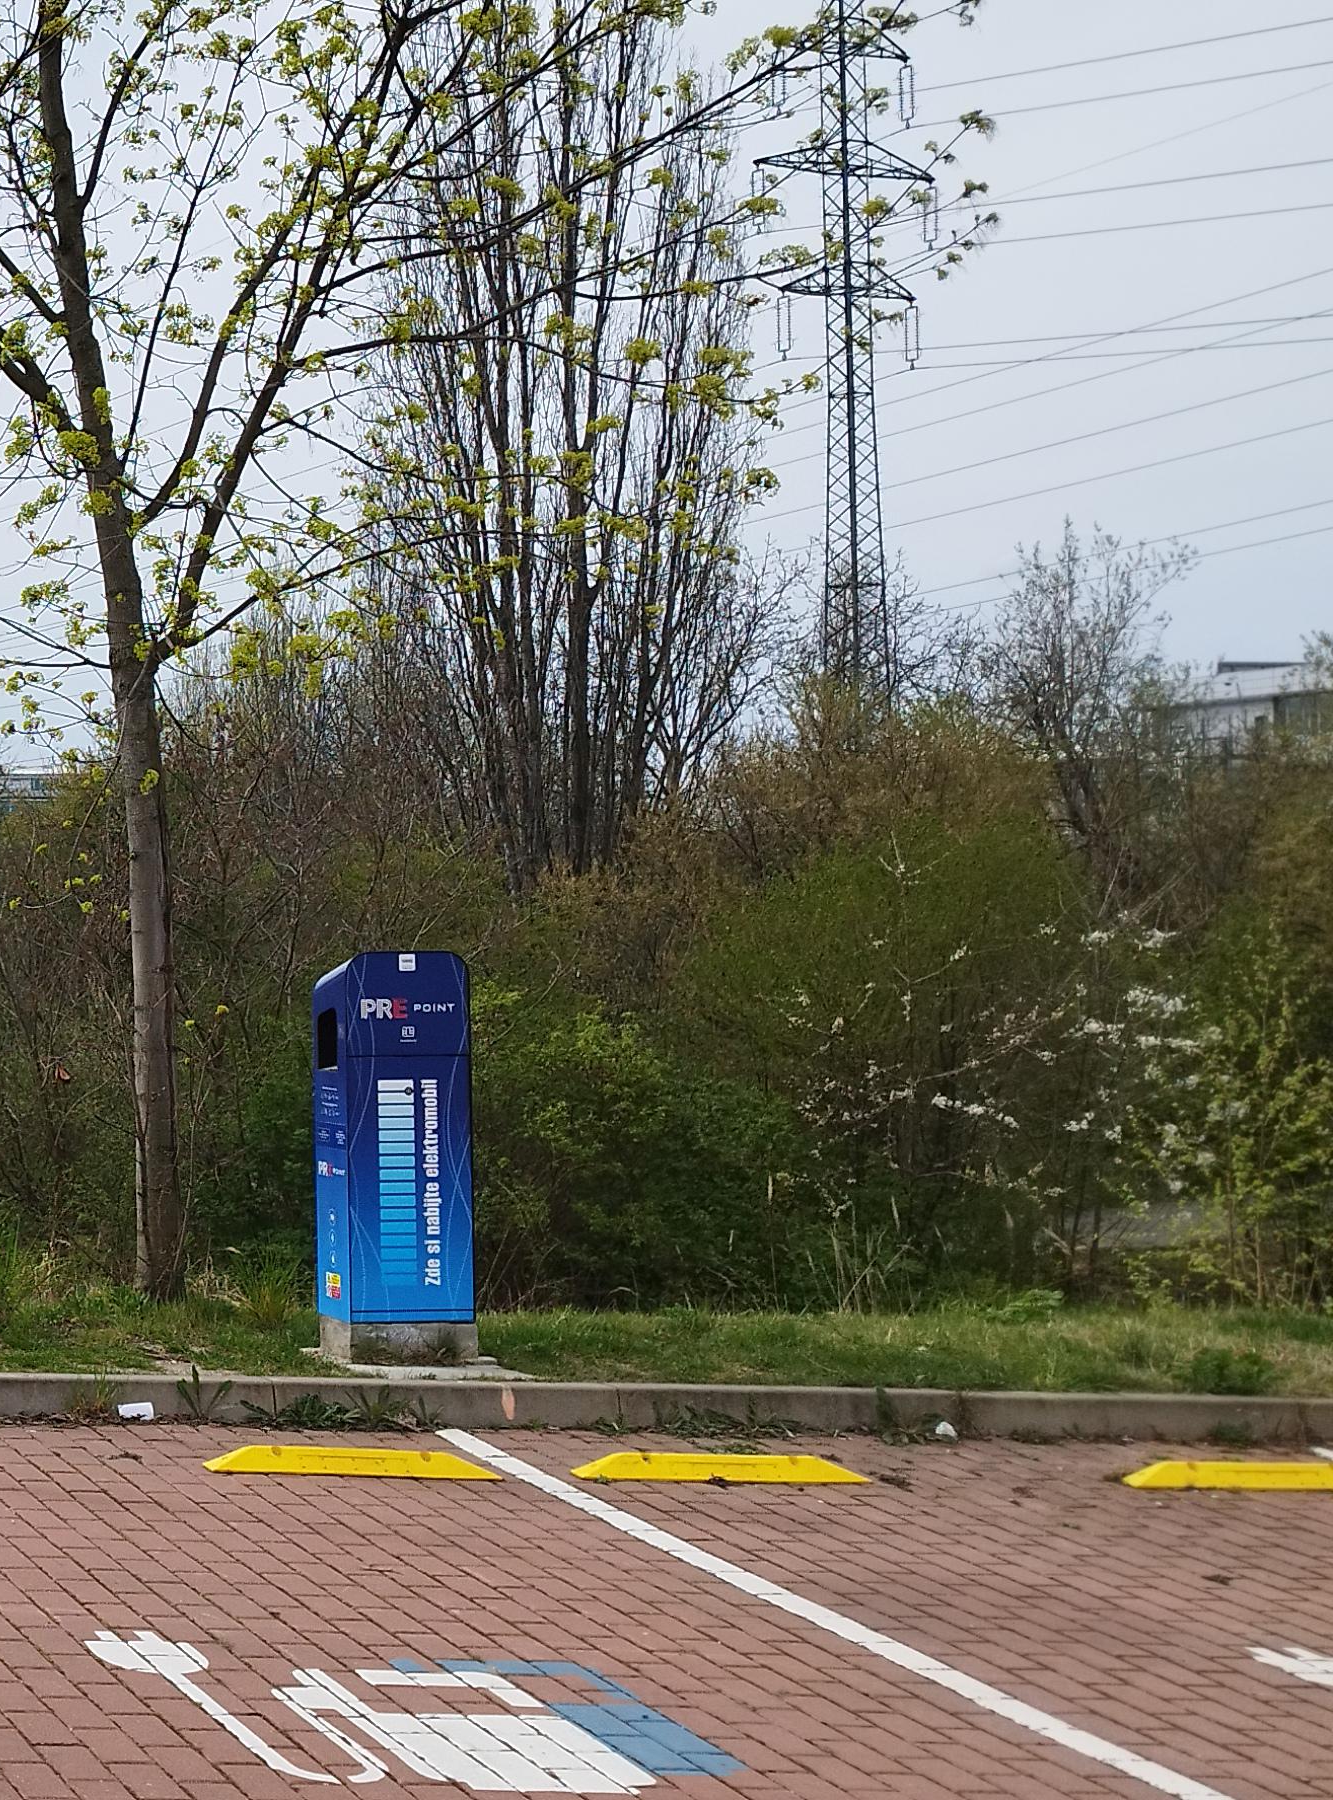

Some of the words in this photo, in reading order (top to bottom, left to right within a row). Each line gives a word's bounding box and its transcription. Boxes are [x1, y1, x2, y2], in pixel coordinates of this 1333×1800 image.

[360, 998, 408, 1020] PRE
[413, 1002, 455, 1013] POINT
[420, 1078, 440, 1178] elektromobil
[423, 1182, 442, 1235] nabijte
[424, 1239, 441, 1254] si
[424, 1258, 441, 1286] Zde
